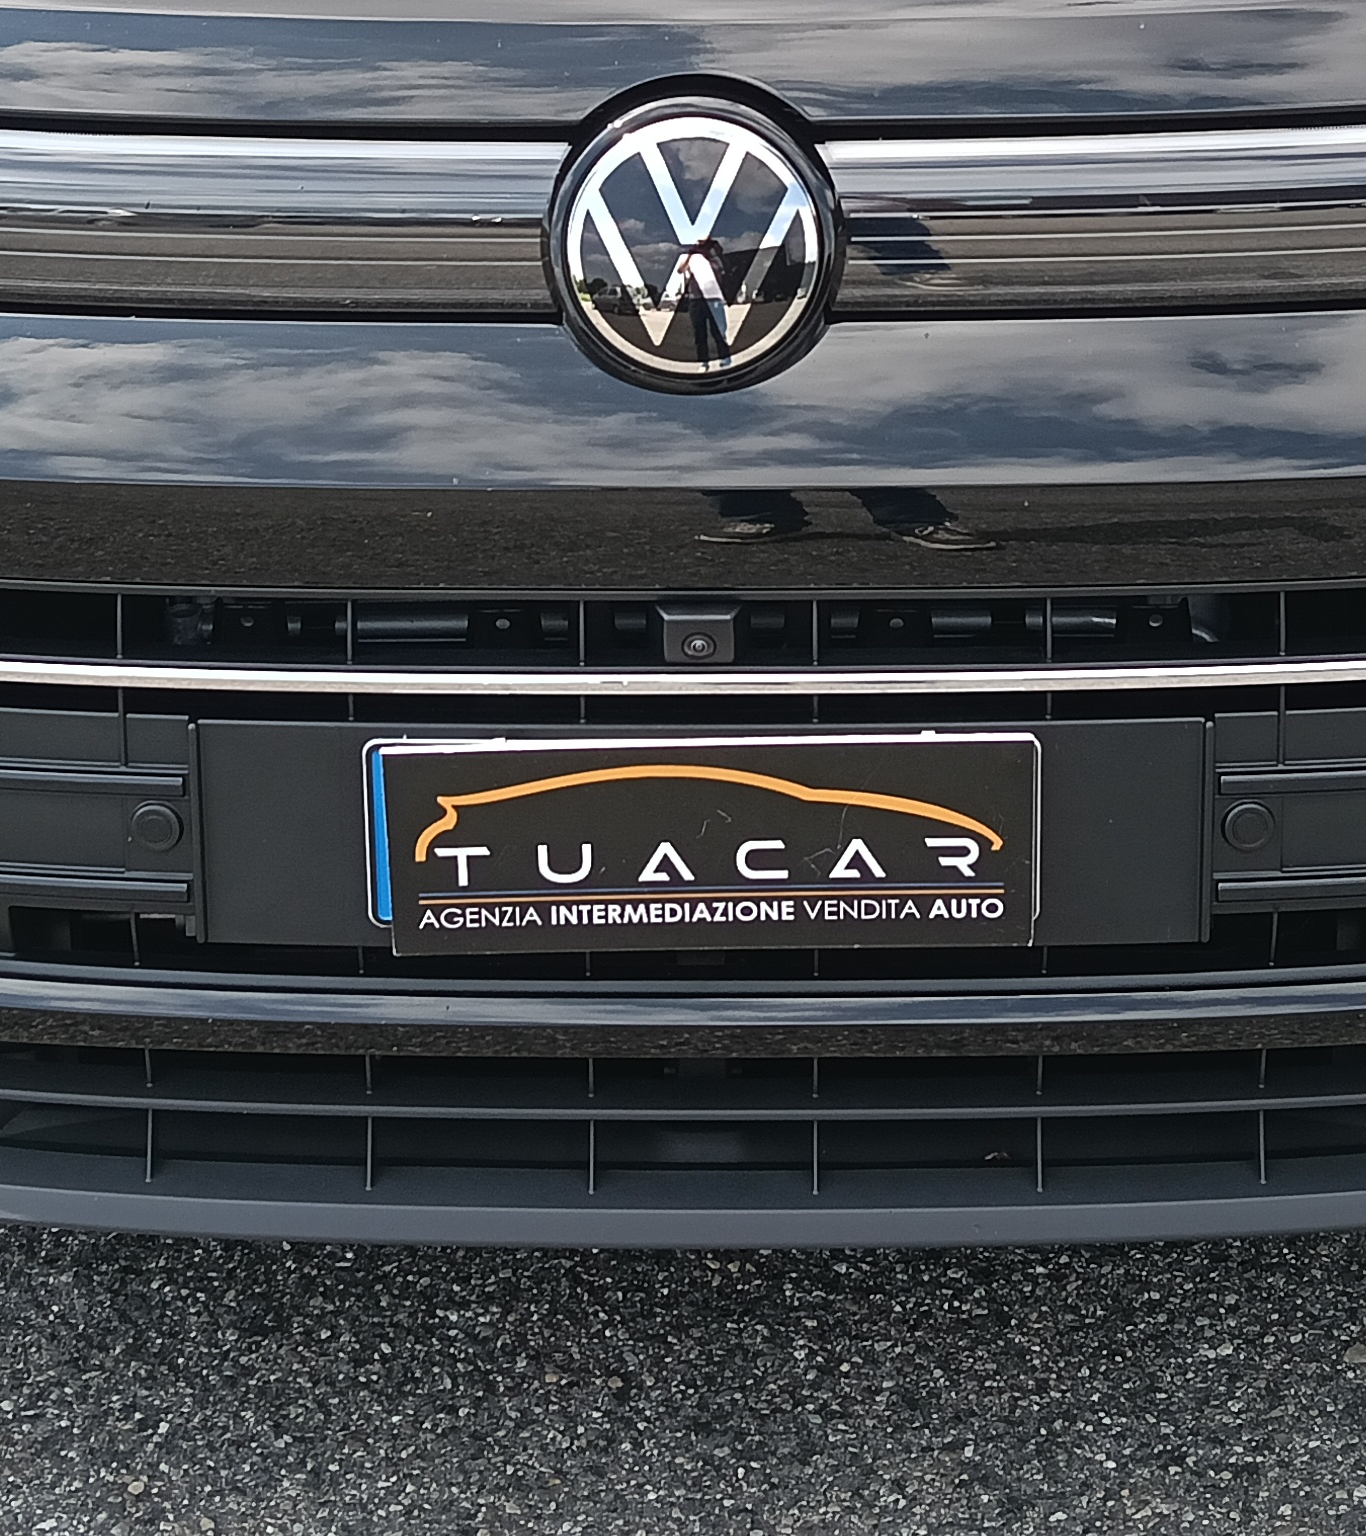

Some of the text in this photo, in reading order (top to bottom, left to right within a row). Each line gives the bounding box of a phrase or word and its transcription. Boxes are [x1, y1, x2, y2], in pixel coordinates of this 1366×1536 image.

[433, 837, 980, 887] TUACAR
[418, 898, 1005, 930] AGENZIA INTERMEDIAZIONE VENDITA AUTO
